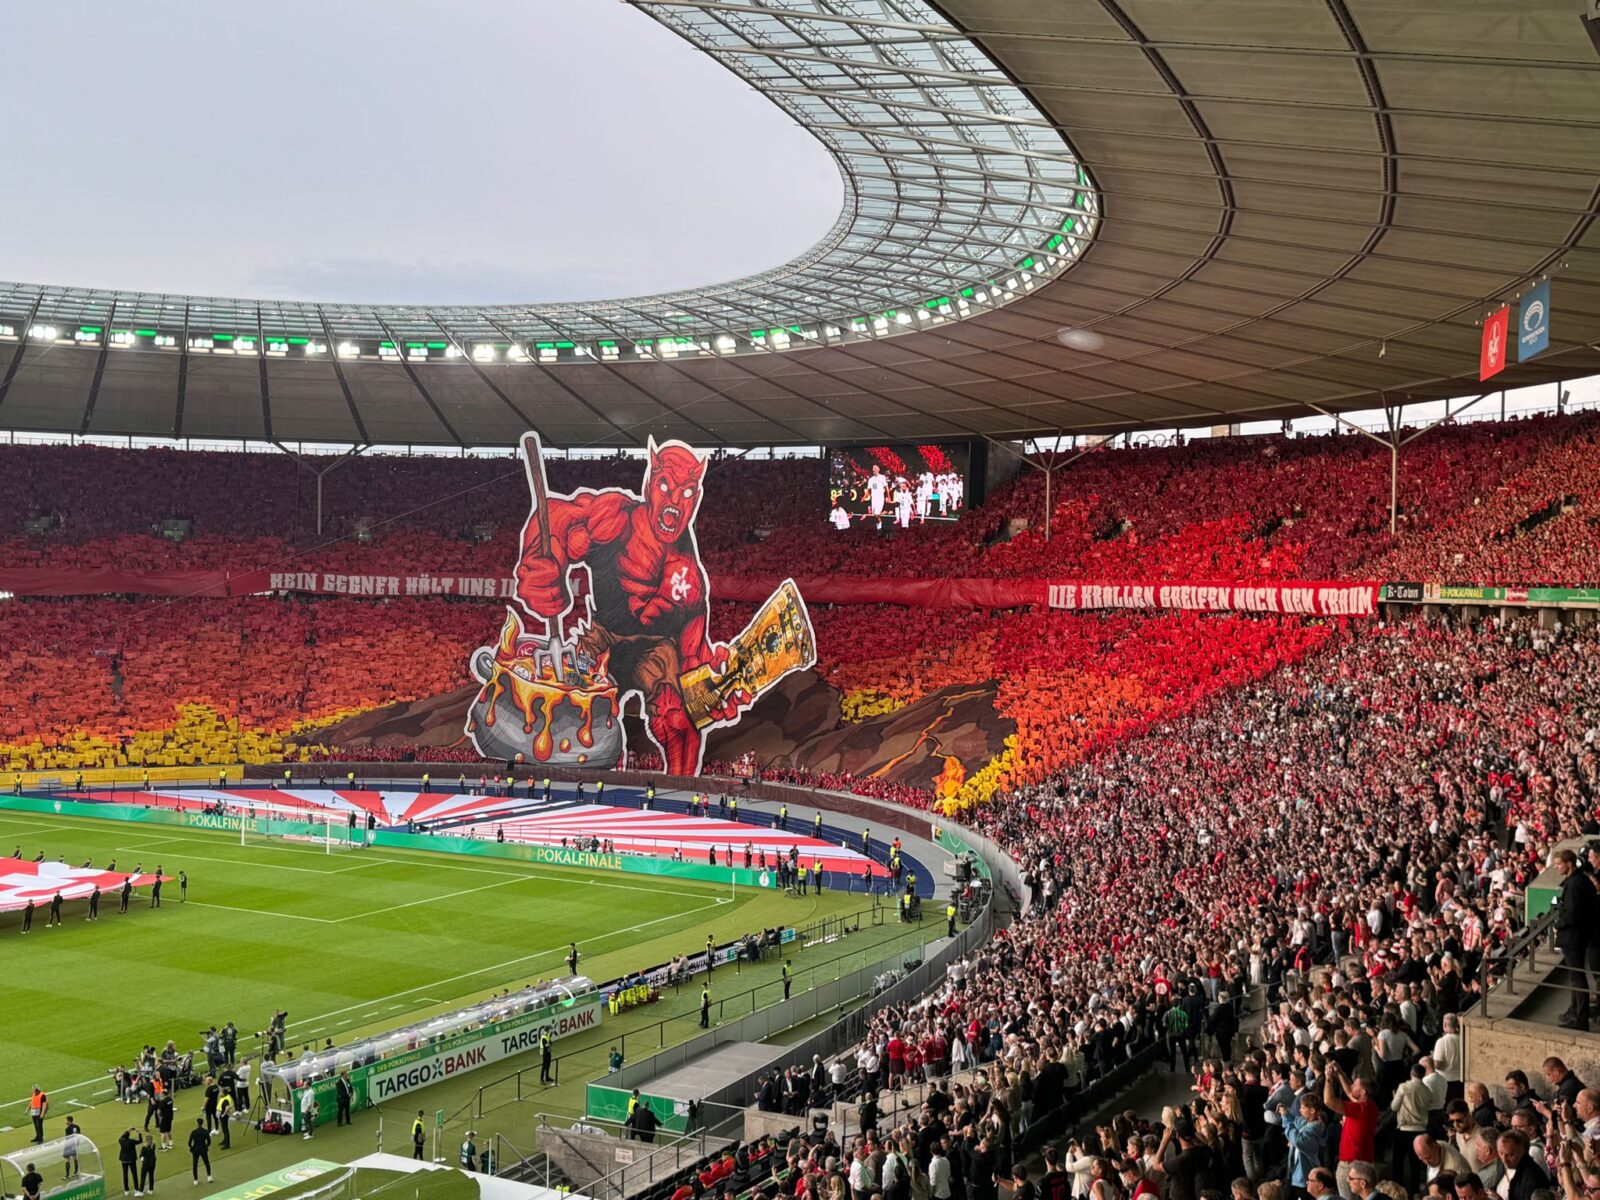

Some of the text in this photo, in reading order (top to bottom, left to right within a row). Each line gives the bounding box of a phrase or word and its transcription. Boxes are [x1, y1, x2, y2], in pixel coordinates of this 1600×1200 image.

[270, 572, 318, 591] KEIN
[322, 574, 400, 595] GEGNER
[405, 573, 454, 595] HÄLT
[458, 577, 496, 596] UNS
[1049, 585, 1374, 615] DIE KRALLEN GREIFEN NACH DEM TRAUM
[189, 813, 257, 832] POKALFINALE
[537, 847, 622, 870] POKALFINALE
[560, 1009, 595, 1034] BANK
[376, 1045, 486, 1098] TARGO BANK
